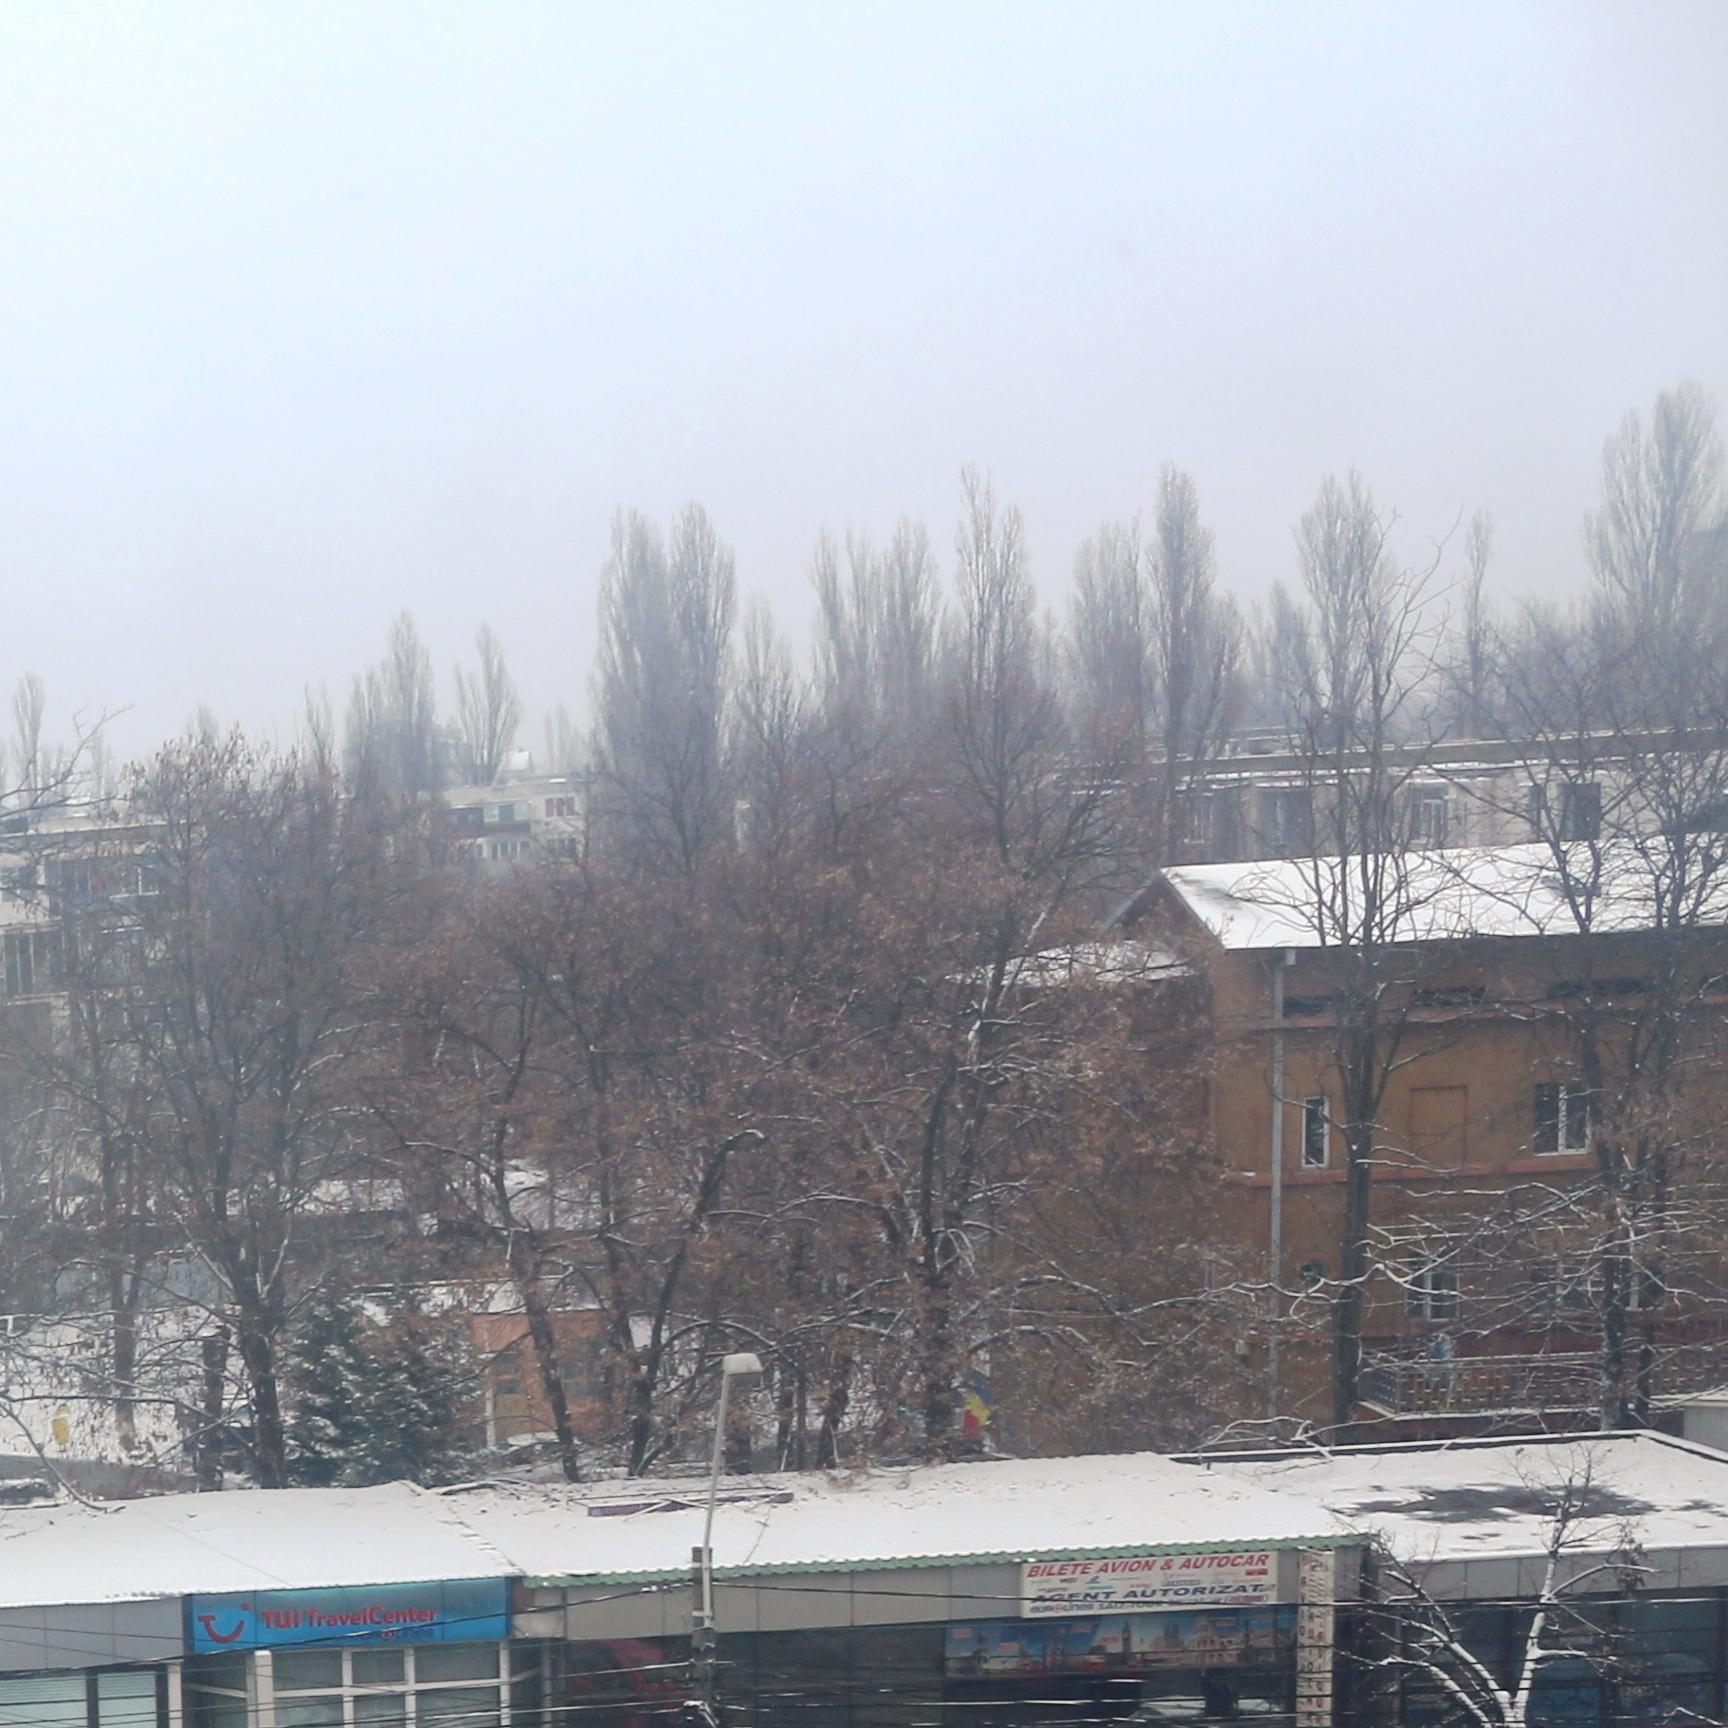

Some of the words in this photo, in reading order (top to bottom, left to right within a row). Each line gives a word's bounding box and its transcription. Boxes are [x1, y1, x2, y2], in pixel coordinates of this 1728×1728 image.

[1027, 1562, 1097, 1577] BILETE
[1099, 1557, 1156, 1574] AVION
[1160, 1557, 1173, 1570] &
[1176, 1554, 1269, 1570] AUTOCAR
[261, 1610, 300, 1629] TUI
[308, 1606, 437, 1627] TravelCenter
